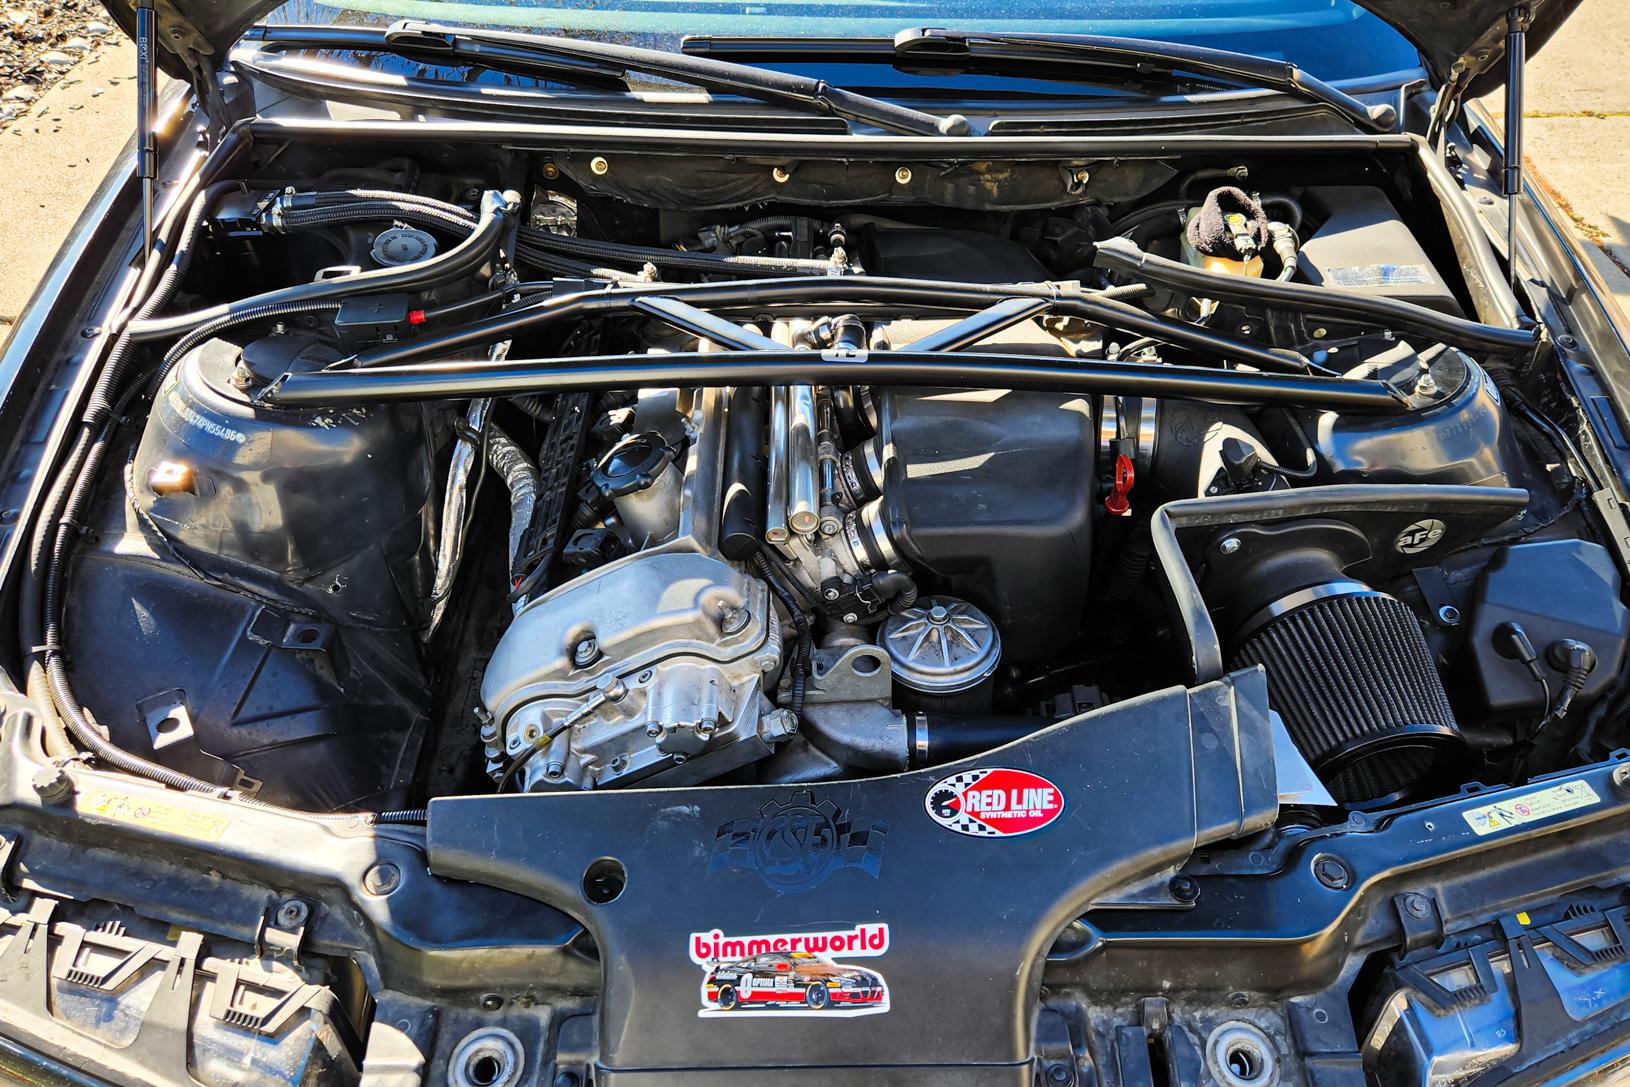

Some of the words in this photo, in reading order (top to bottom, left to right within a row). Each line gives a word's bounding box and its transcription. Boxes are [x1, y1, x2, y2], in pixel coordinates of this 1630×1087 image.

[1398, 529, 1442, 547] aFe
[966, 789, 1006, 812] RED
[980, 810, 1026, 820] SYNTHETIC
[1028, 810, 1043, 818] OIL
[694, 927, 885, 959] bimmerworld
